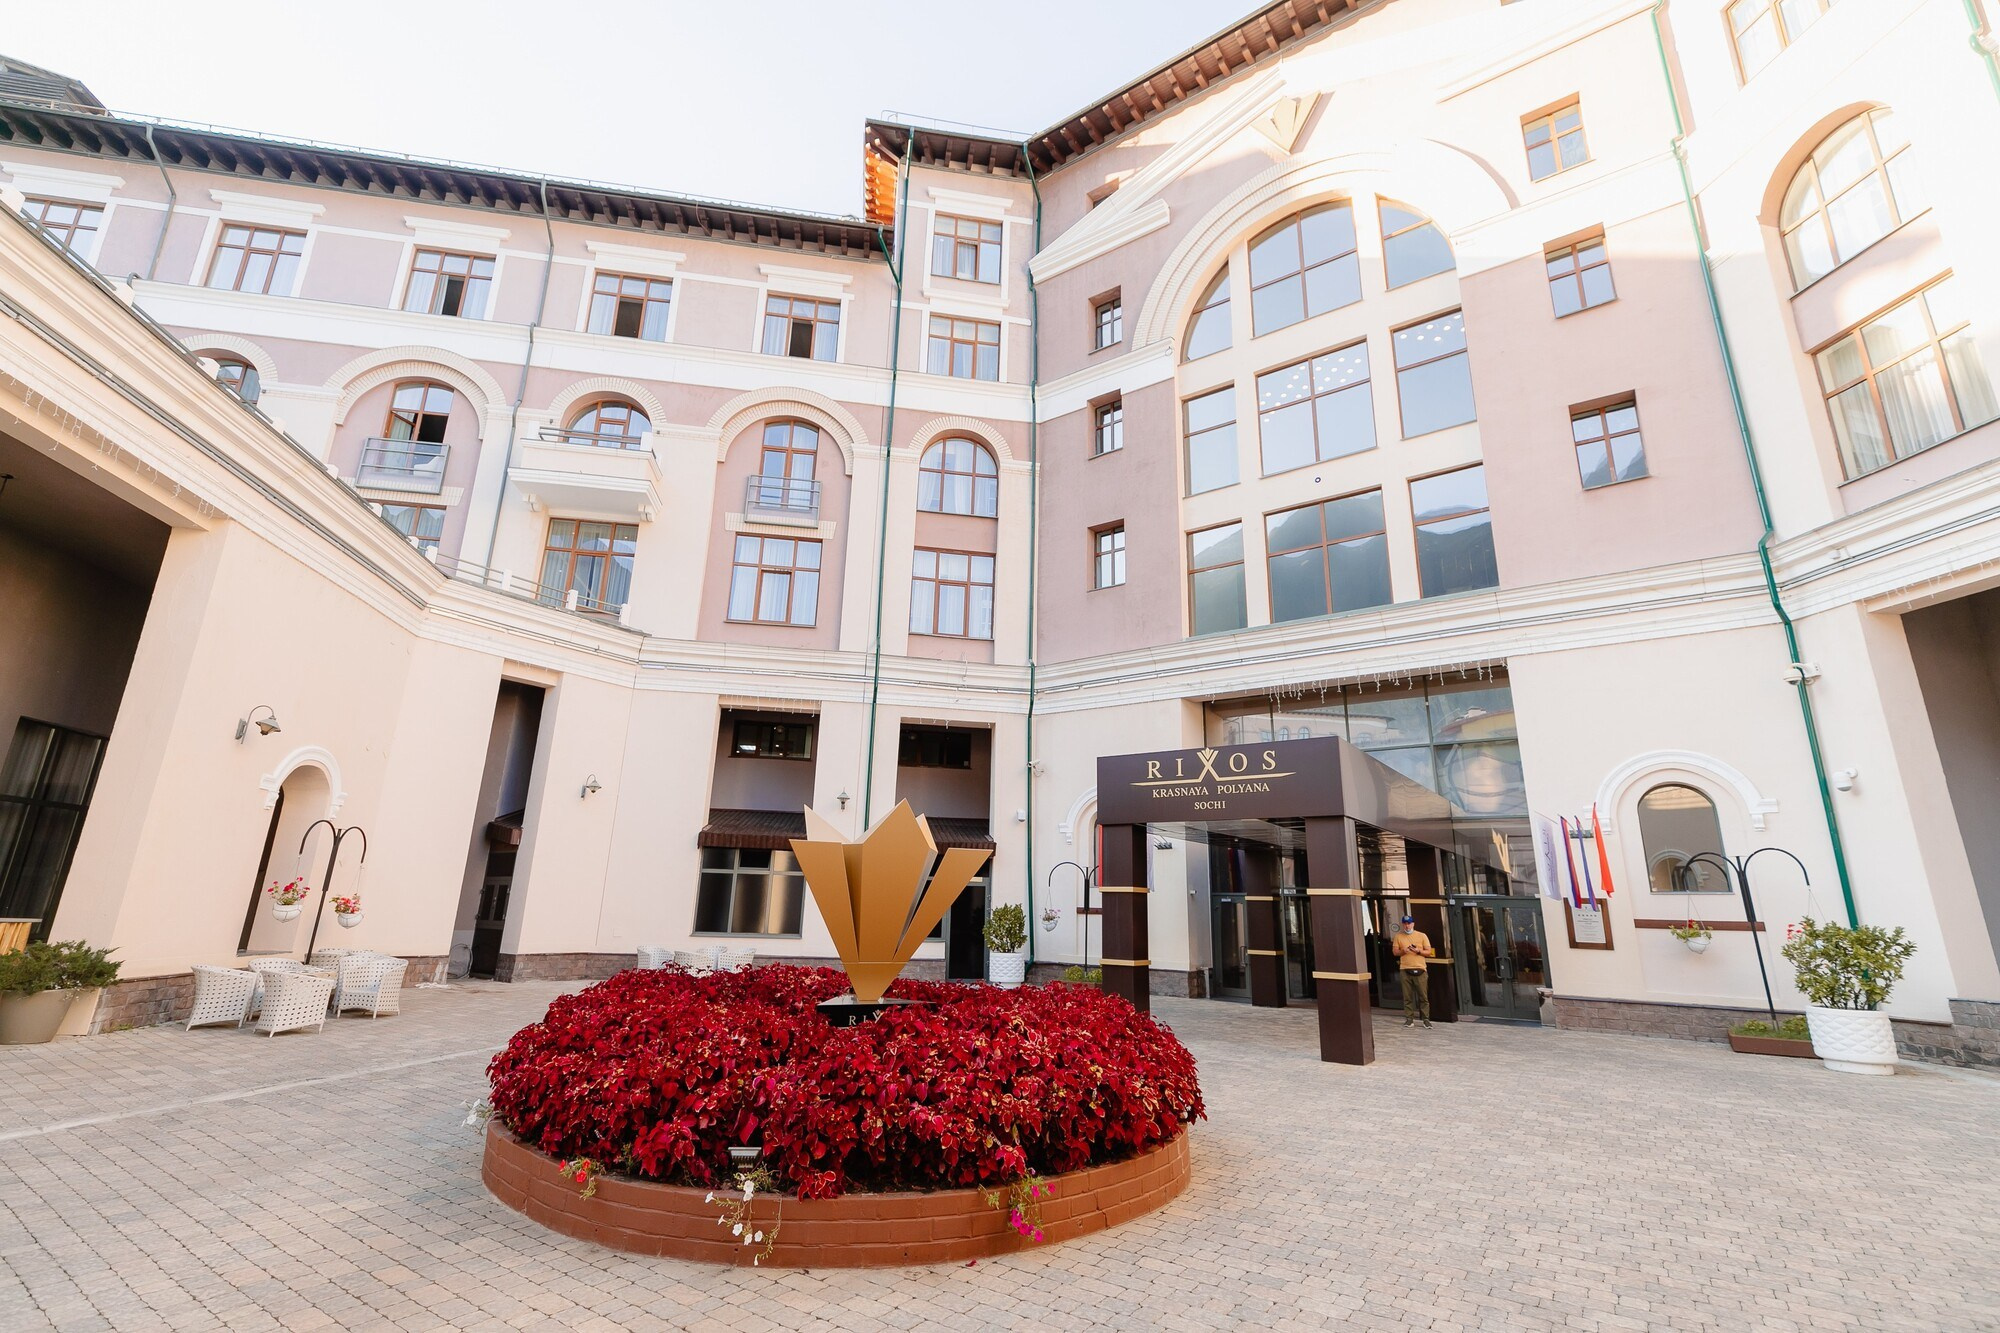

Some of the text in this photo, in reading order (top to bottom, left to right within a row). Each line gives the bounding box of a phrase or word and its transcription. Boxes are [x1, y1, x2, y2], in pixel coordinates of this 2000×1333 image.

[1146, 748, 1277, 780] RIXOS
[1152, 782, 1271, 798] KRASNAYA POLYANA
[1194, 800, 1226, 810] SOCHI
